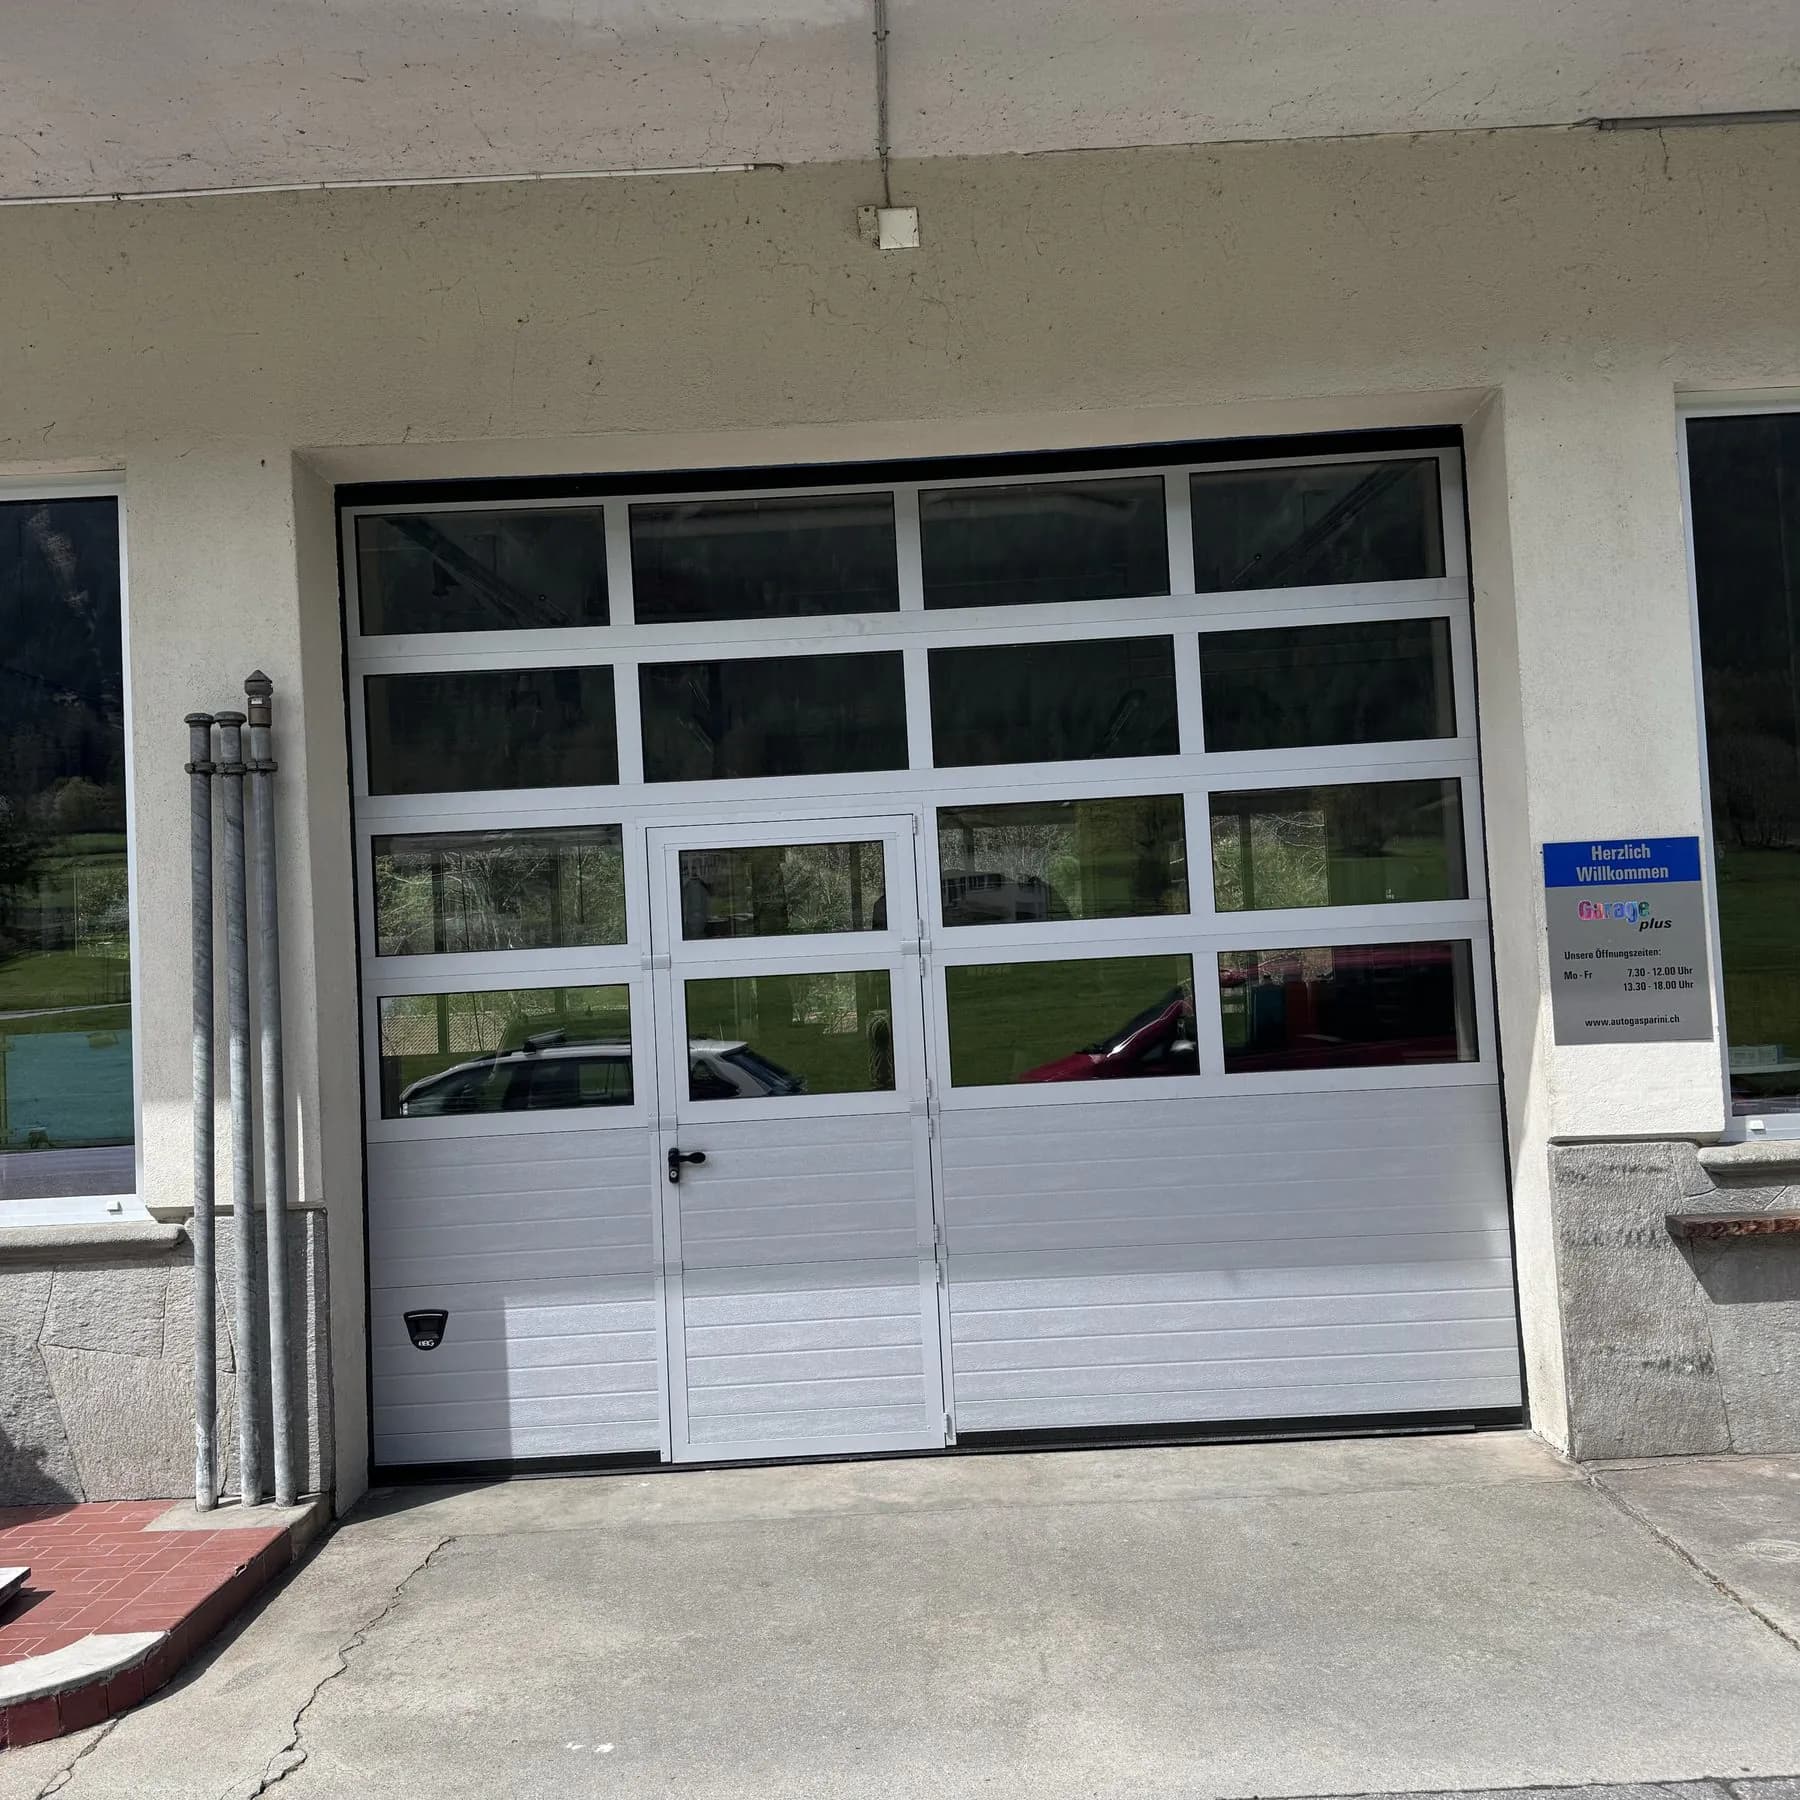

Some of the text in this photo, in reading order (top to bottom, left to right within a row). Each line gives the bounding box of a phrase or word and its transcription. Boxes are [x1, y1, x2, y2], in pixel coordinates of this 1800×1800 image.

[1591, 844, 1651, 861] Herzlich
[1576, 866, 1669, 882] Willkommen
[1577, 899, 1650, 924] Garage
[1639, 917, 1672, 932] plus
[1564, 948, 1661, 960] Unsere Öffnungszeiten:
[1564, 971, 1578, 980] Mo
[1584, 971, 1593, 979] Fr
[1627, 968, 1646, 977] 7.30
[1653, 966, 1676, 976] 12.00
[1678, 966, 1693, 975] Uhr
[1624, 982, 1647, 991] 13.30
[1654, 980, 1677, 990] 18.00
[1679, 980, 1694, 989] Uhr
[1585, 1014, 1680, 1027] www.autogasparini.ch
